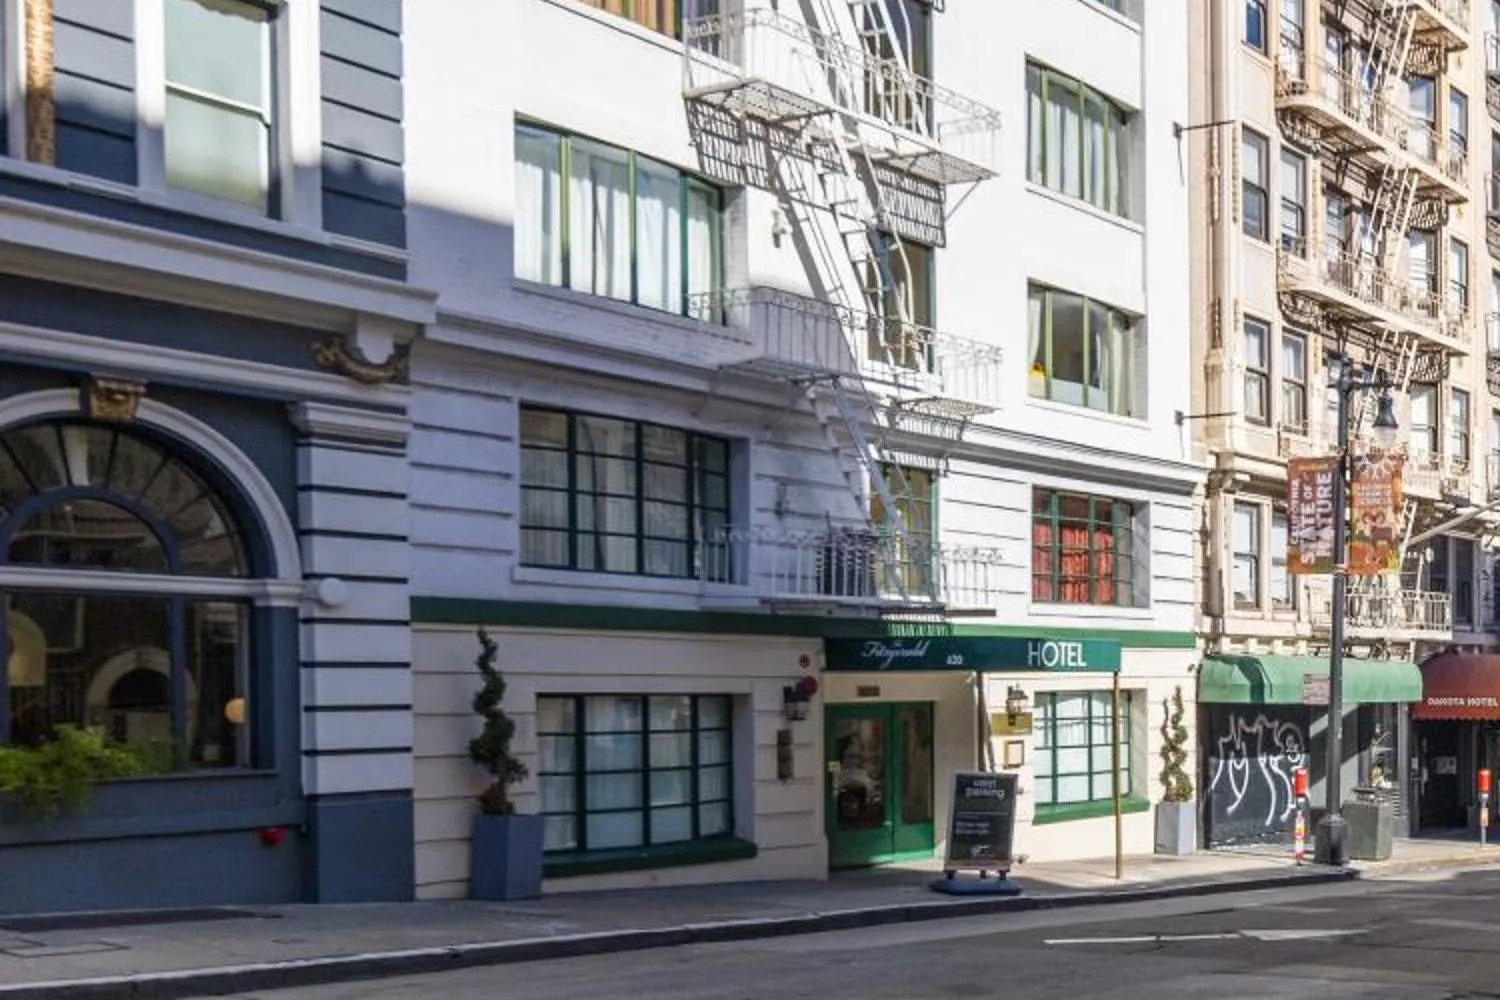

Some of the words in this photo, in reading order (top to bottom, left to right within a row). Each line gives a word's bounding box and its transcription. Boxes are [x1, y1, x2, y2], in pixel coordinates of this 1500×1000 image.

[1316, 471, 1333, 557] NATURE
[1300, 502, 1316, 565] STATE
[861, 640, 931, 669] Fitzgerald
[1028, 641, 1087, 667] HOTEL
[1428, 697, 1464, 706] DAKOTA
[1467, 697, 1499, 708] HOTEL
